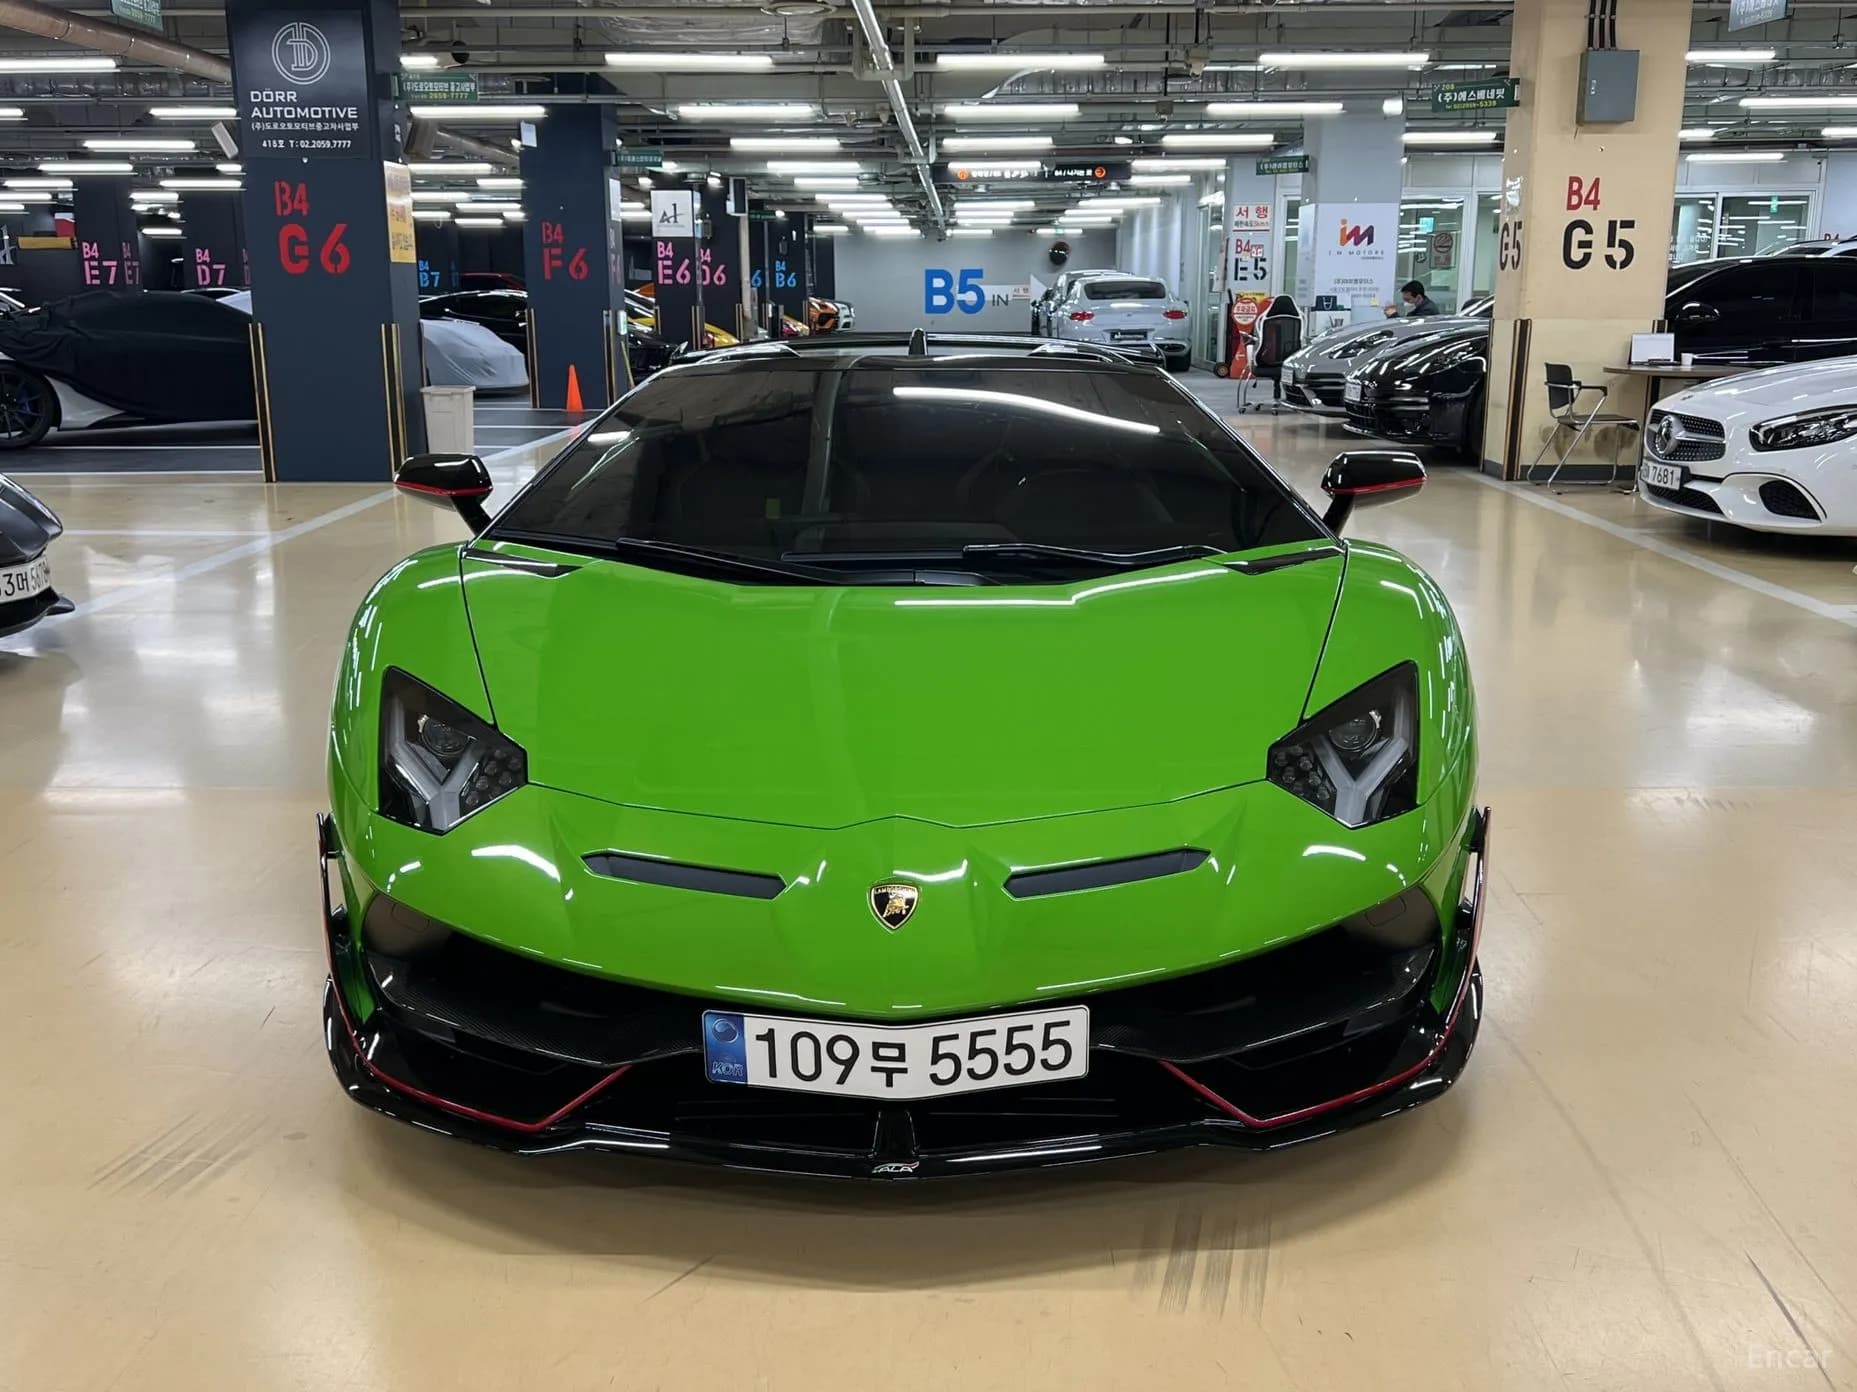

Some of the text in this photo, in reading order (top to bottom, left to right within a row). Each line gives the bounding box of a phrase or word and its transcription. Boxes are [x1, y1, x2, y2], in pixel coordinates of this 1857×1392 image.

[250, 88, 297, 102] DÖRR
[1438, 88, 1505, 103] (주)에스베네핏
[251, 106, 358, 119] AUTOMOTIVE
[274, 180, 310, 217] B4
[1566, 176, 1601, 211] B4
[542, 222, 564, 244] B4
[82, 242, 99, 259] B4
[195, 248, 210, 263] B4
[657, 241, 674, 259] B4
[84, 260, 118, 285] E7
[196, 264, 226, 285] D7
[419, 271, 441, 288] B7
[657, 258, 691, 285] E6
[1234, 257, 1268, 281] E5
[775, 272, 798, 288] B6
[924, 268, 986, 315] B5
[991, 294, 1009, 307] IN
[1652, 465, 1675, 486] 7681
[0, 571, 30, 597] 3머
[755, 1019, 1073, 1088] 109무 5555
[712, 1061, 744, 1077] KOR
